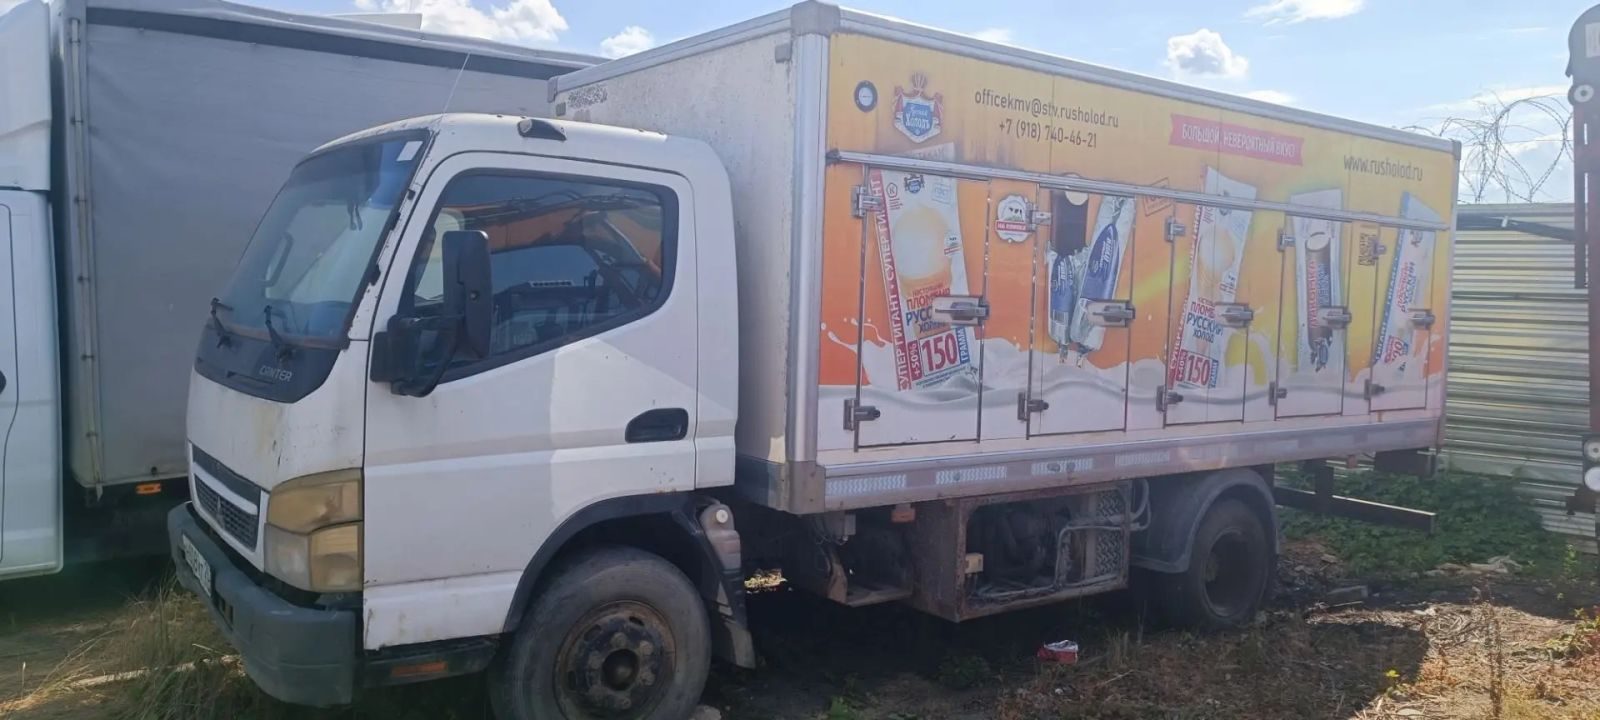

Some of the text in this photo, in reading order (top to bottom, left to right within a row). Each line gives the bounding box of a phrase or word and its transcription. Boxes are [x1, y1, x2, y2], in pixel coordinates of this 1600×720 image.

[974, 88, 1119, 128] officekmv@stv.rusholod.ru
[999, 118, 1097, 148] +7 (918) 740-46-21
[1343, 155, 1423, 181] www.rusholod.ru
[880, 236, 896, 281] СУПЕР
[889, 294, 904, 346] ГИГАНТ
[905, 305, 933, 326] РУСС
[911, 343, 921, 378] +50%
[922, 332, 958, 372] 150
[260, 365, 292, 382] CANTER
[1187, 354, 1210, 386] 150
